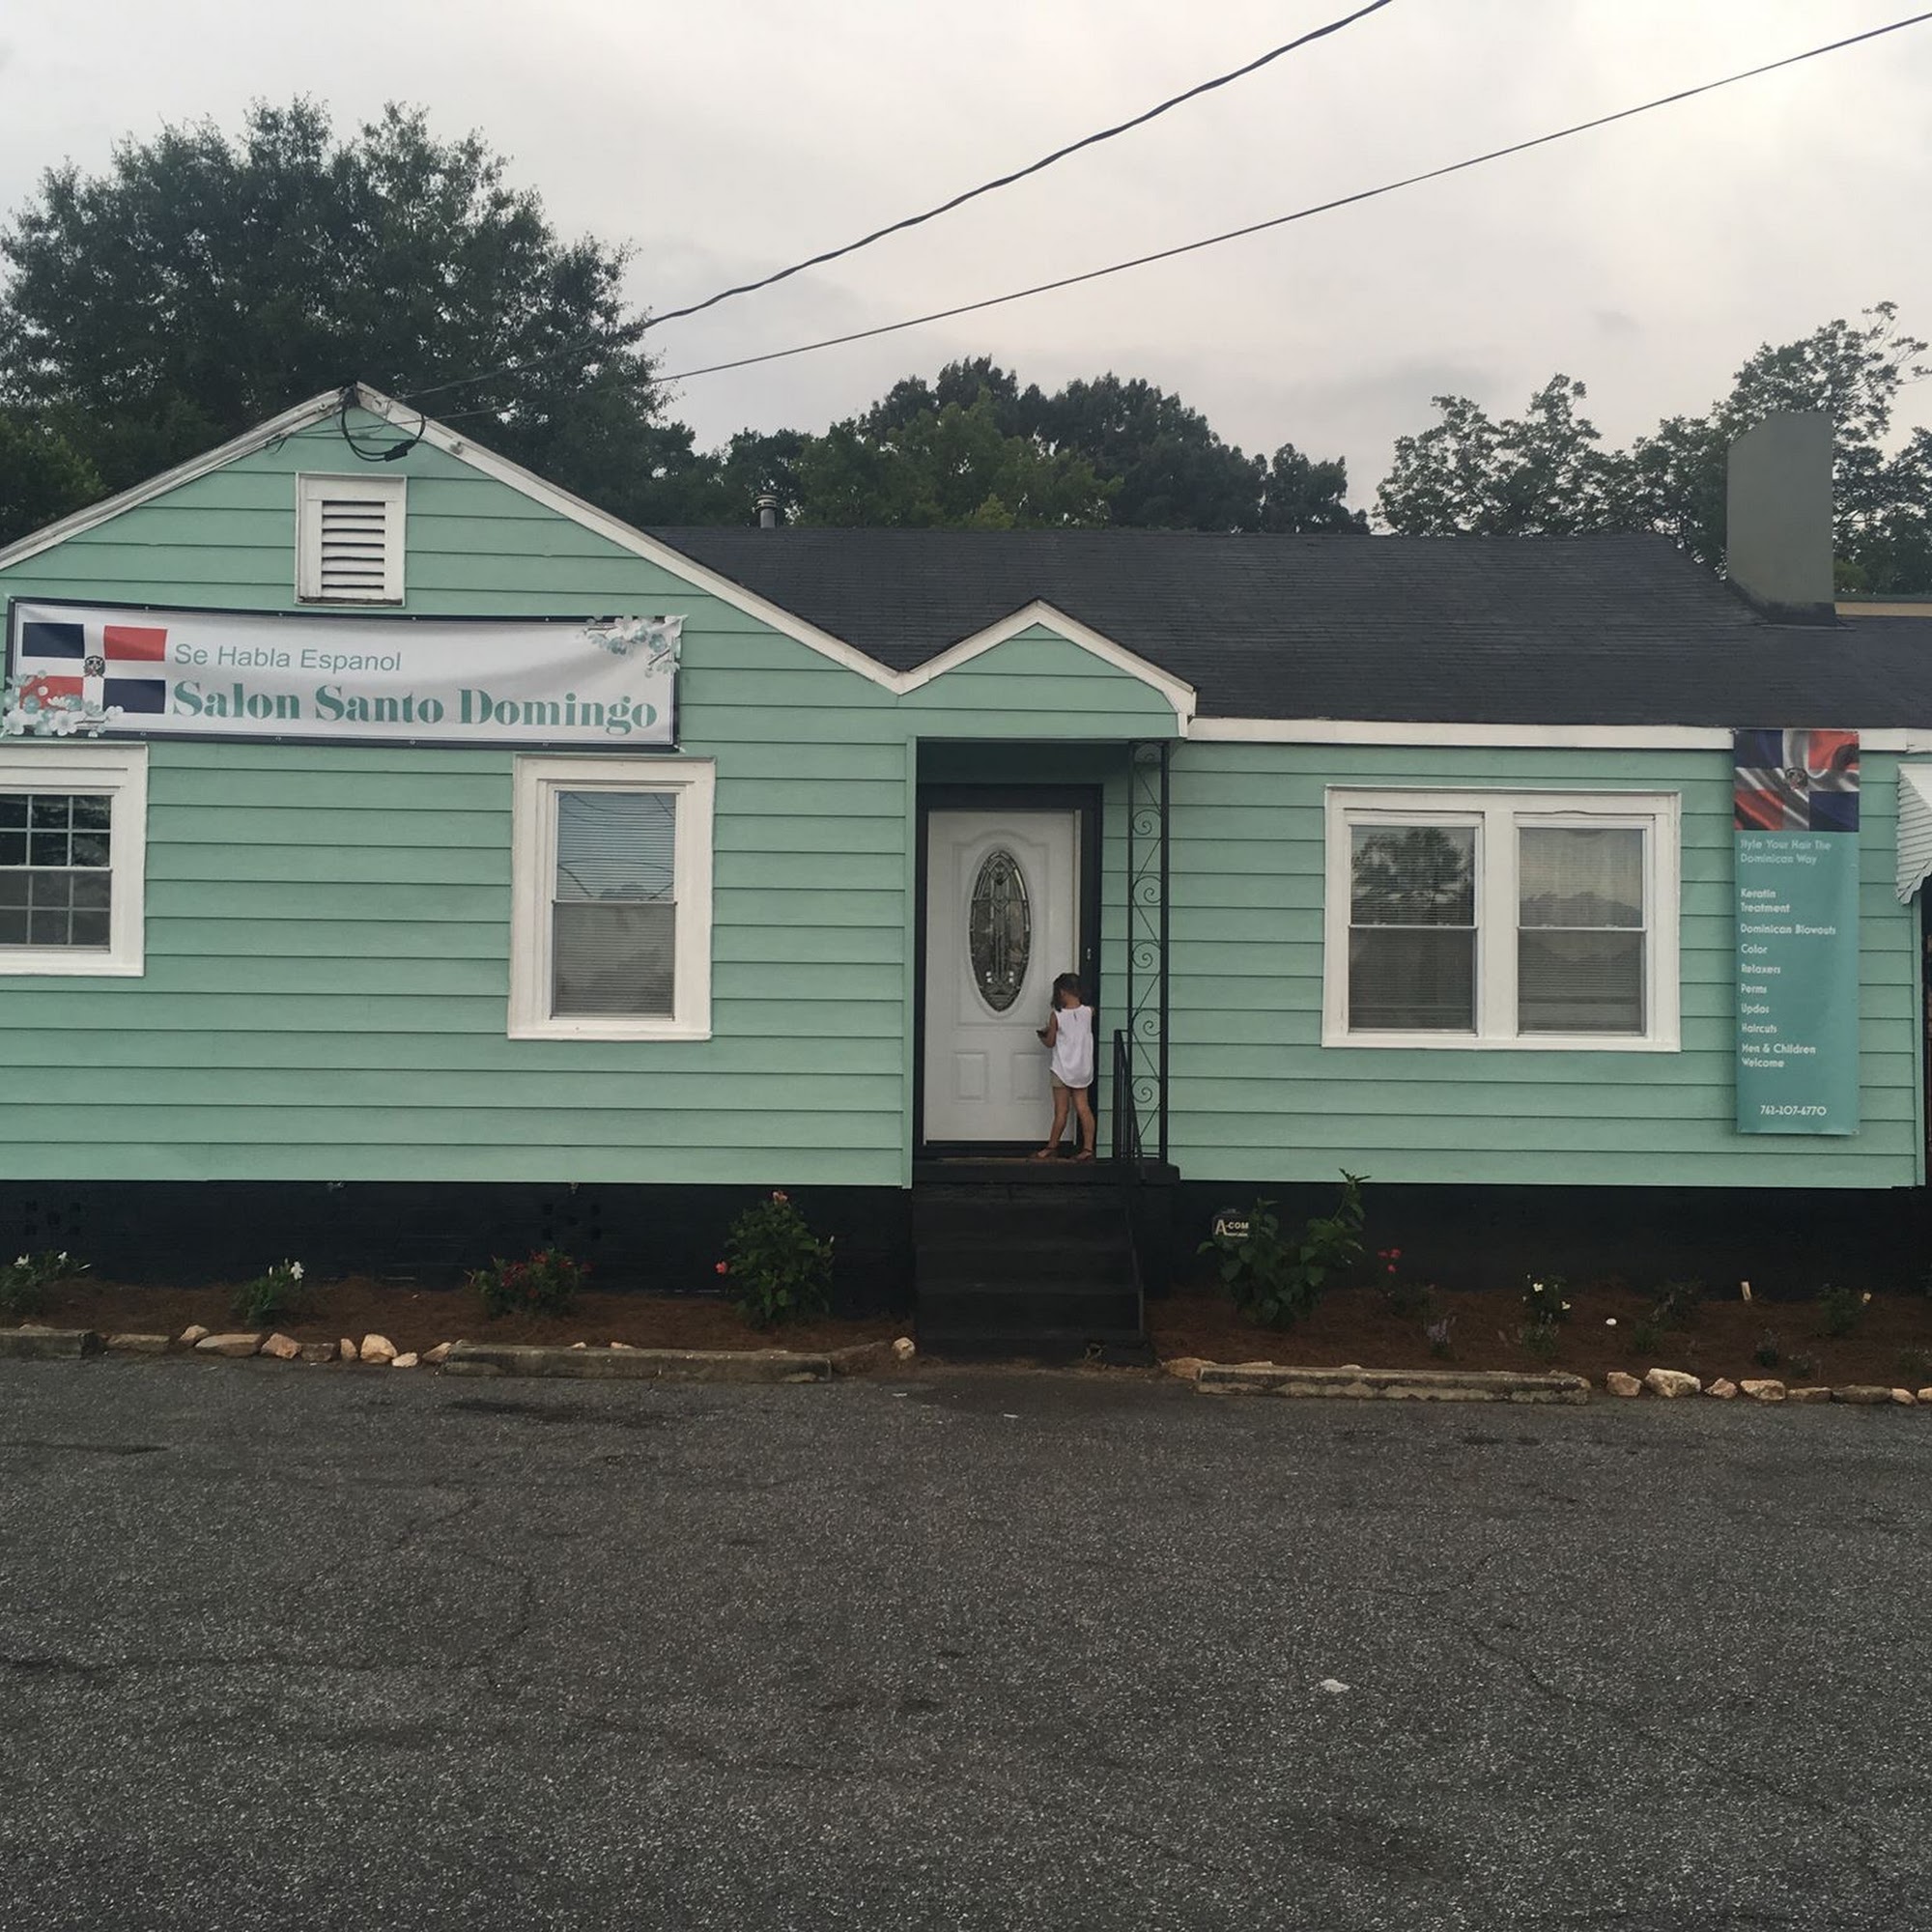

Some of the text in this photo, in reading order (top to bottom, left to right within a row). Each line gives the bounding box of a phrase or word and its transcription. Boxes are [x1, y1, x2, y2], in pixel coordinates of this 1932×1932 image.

[174, 642, 402, 673] Se Habla Espanol
[172, 679, 659, 736] Salon Santo Domingo
[1767, 839, 1788, 850] Your
[1791, 839, 1811, 850] Hair
[1814, 839, 1832, 851] The
[1741, 853, 1819, 866] Dominican Way
[1740, 888, 1776, 899] Keratin
[1740, 902, 1790, 913] Treatment
[1740, 923, 1836, 935] Dominican Blowouts
[1741, 944, 1768, 954] Color
[1741, 963, 1781, 975] Relaxers
[1741, 983, 1768, 994] Perms
[1741, 1004, 1770, 1015] Updos
[1741, 1023, 1777, 1034] Haircuts
[1742, 1043, 1816, 1054] Men & Children
[1742, 1057, 1785, 1067] Welcome
